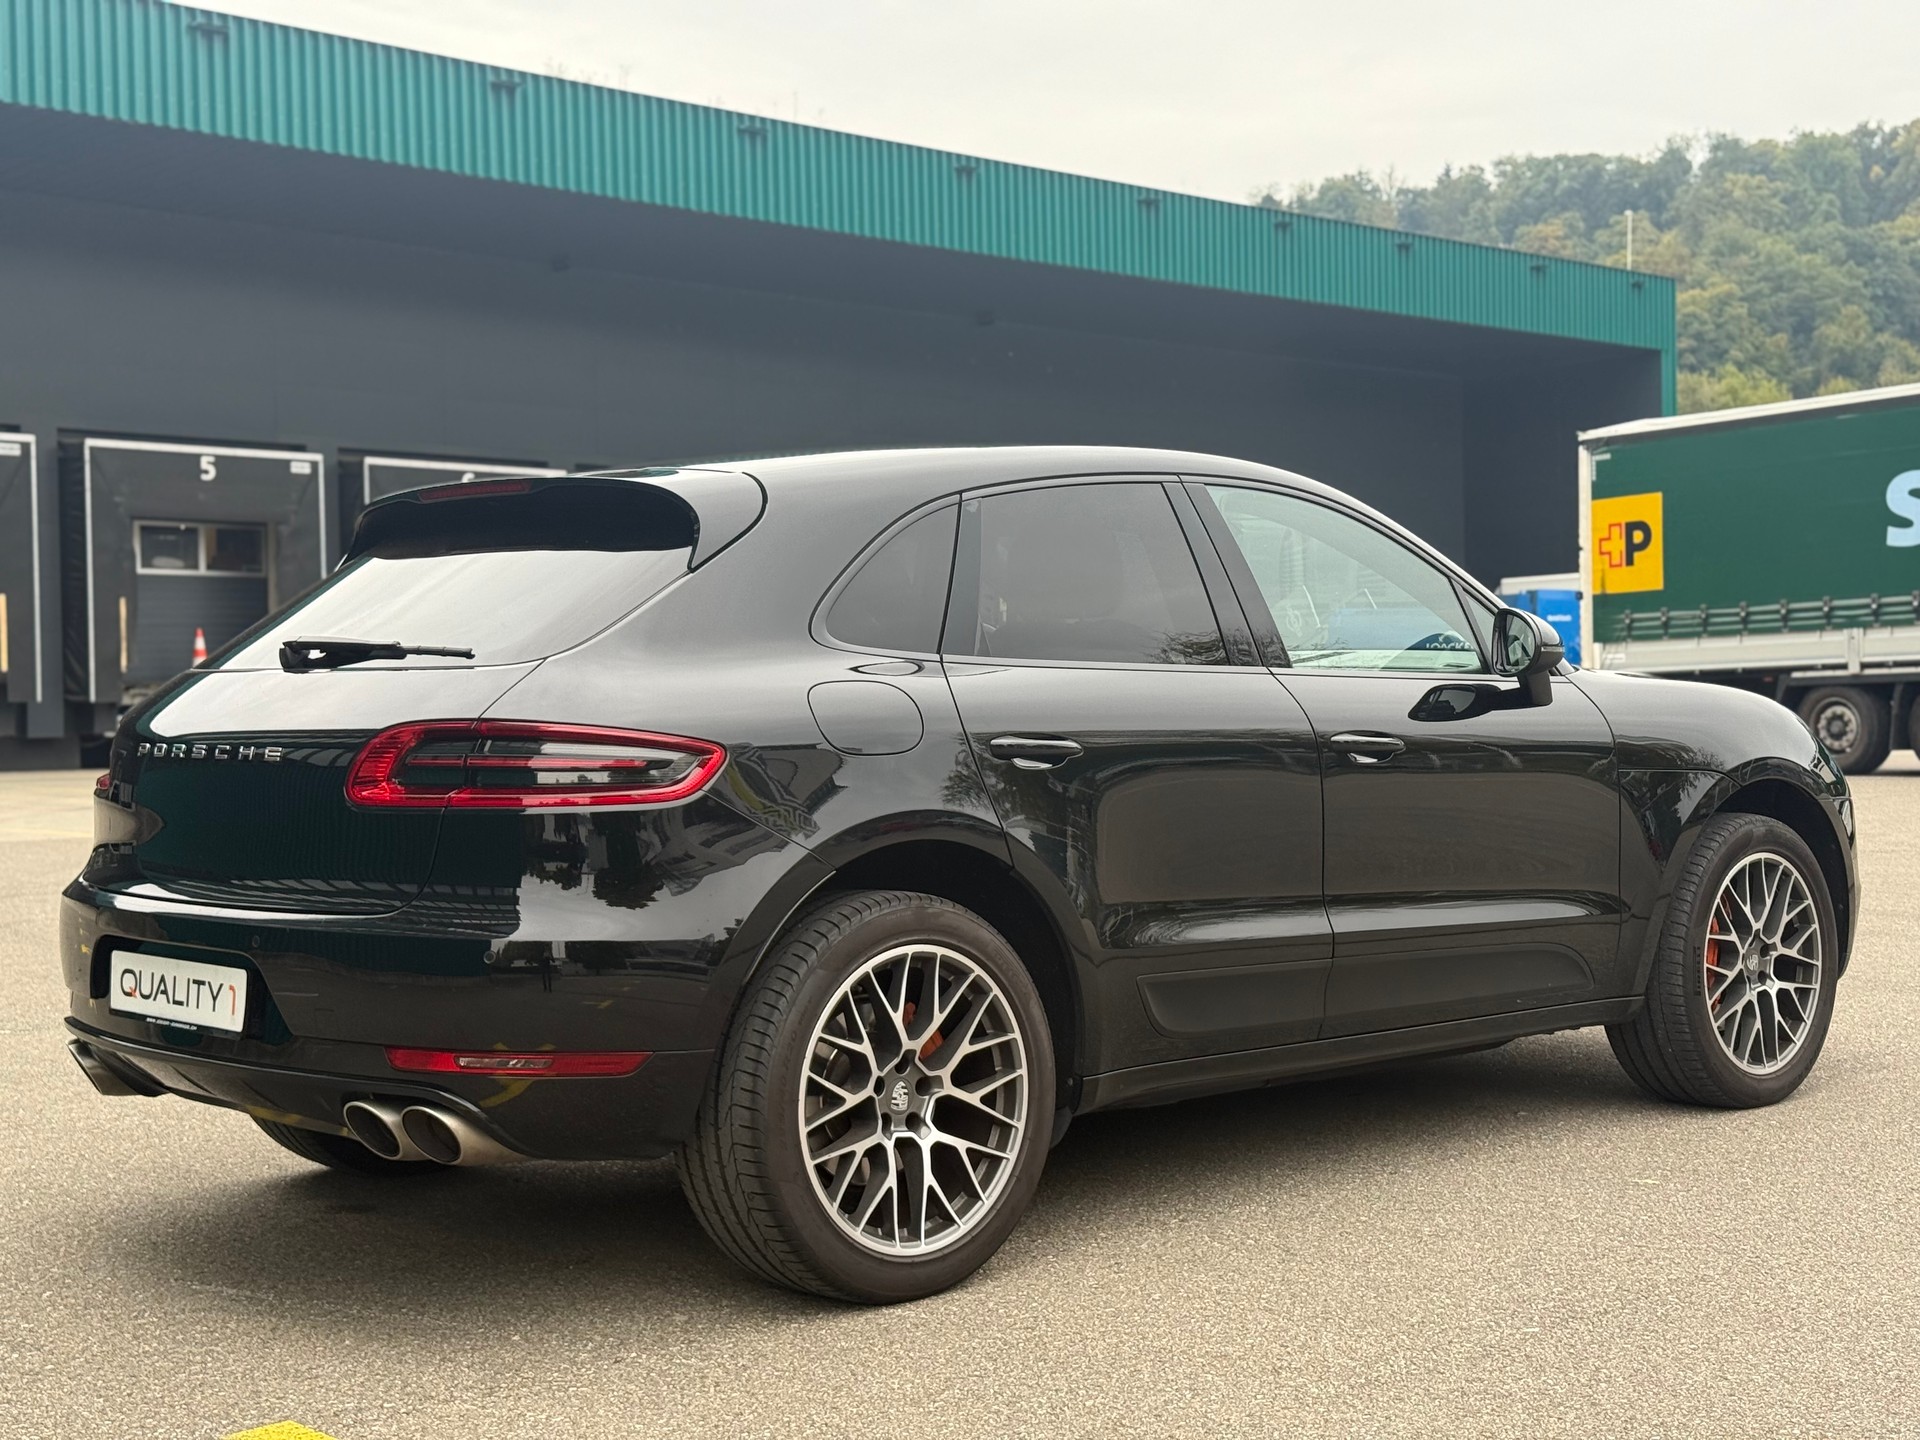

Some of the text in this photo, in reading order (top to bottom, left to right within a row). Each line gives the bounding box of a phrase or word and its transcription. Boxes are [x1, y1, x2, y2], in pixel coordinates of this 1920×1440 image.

[200, 455, 216, 481] 5
[1885, 469, 1920, 547] S
[1625, 520, 1652, 567] P
[137, 742, 284, 761] PORSCHE
